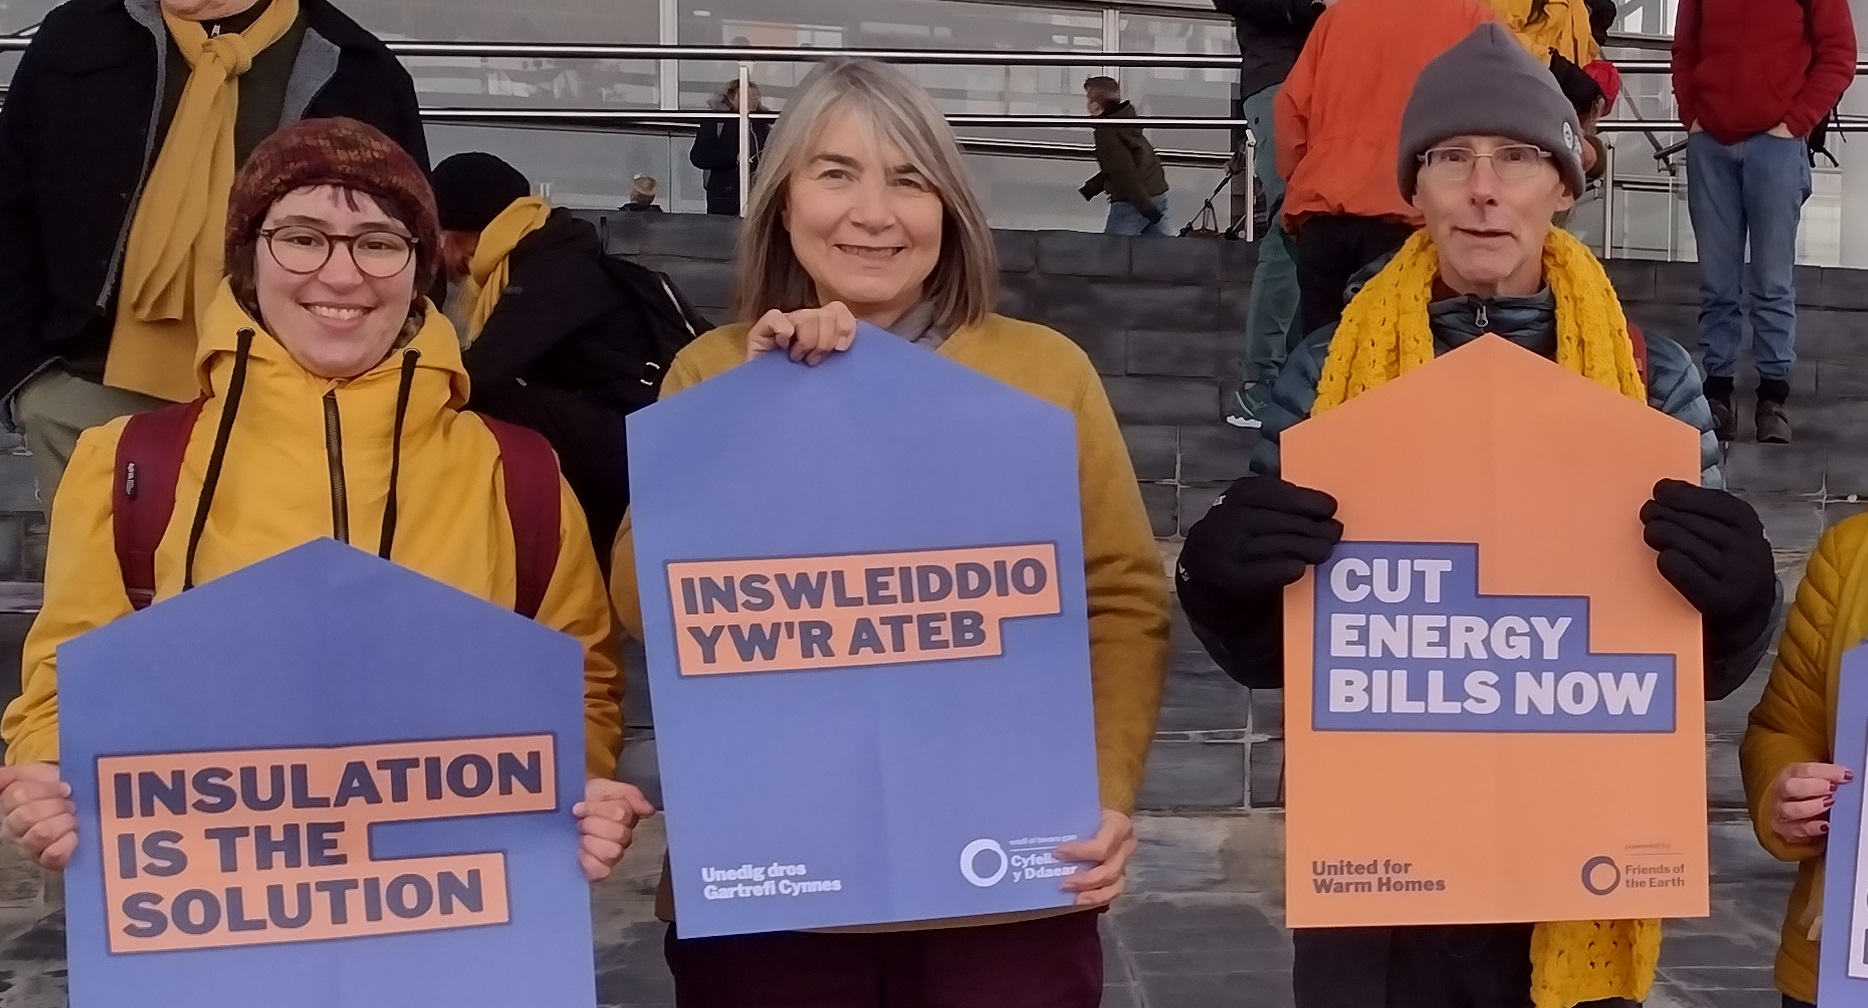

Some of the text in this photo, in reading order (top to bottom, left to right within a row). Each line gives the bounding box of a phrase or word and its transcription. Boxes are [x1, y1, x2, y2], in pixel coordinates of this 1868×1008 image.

[681, 557, 1047, 615] INSWLEIDDIO
[1330, 558, 1452, 603] CUT
[687, 611, 986, 664] YW'R ATEB
[1330, 614, 1572, 660] ENERGY
[1329, 669, 1658, 715] BILLS NOW
[113, 750, 542, 819] INSULATION
[117, 821, 348, 879] IS THE
[701, 862, 806, 882] Unedig dros
[1312, 859, 1413, 876] United for
[1625, 863, 1685, 875] Friends of
[704, 879, 841, 900] Gartrefi Cynnes
[1012, 866, 1078, 882] y Ddaear
[1313, 877, 1446, 893] Warm Homes
[1626, 876, 1685, 888] the Earth
[122, 869, 483, 938] SOLUTION
